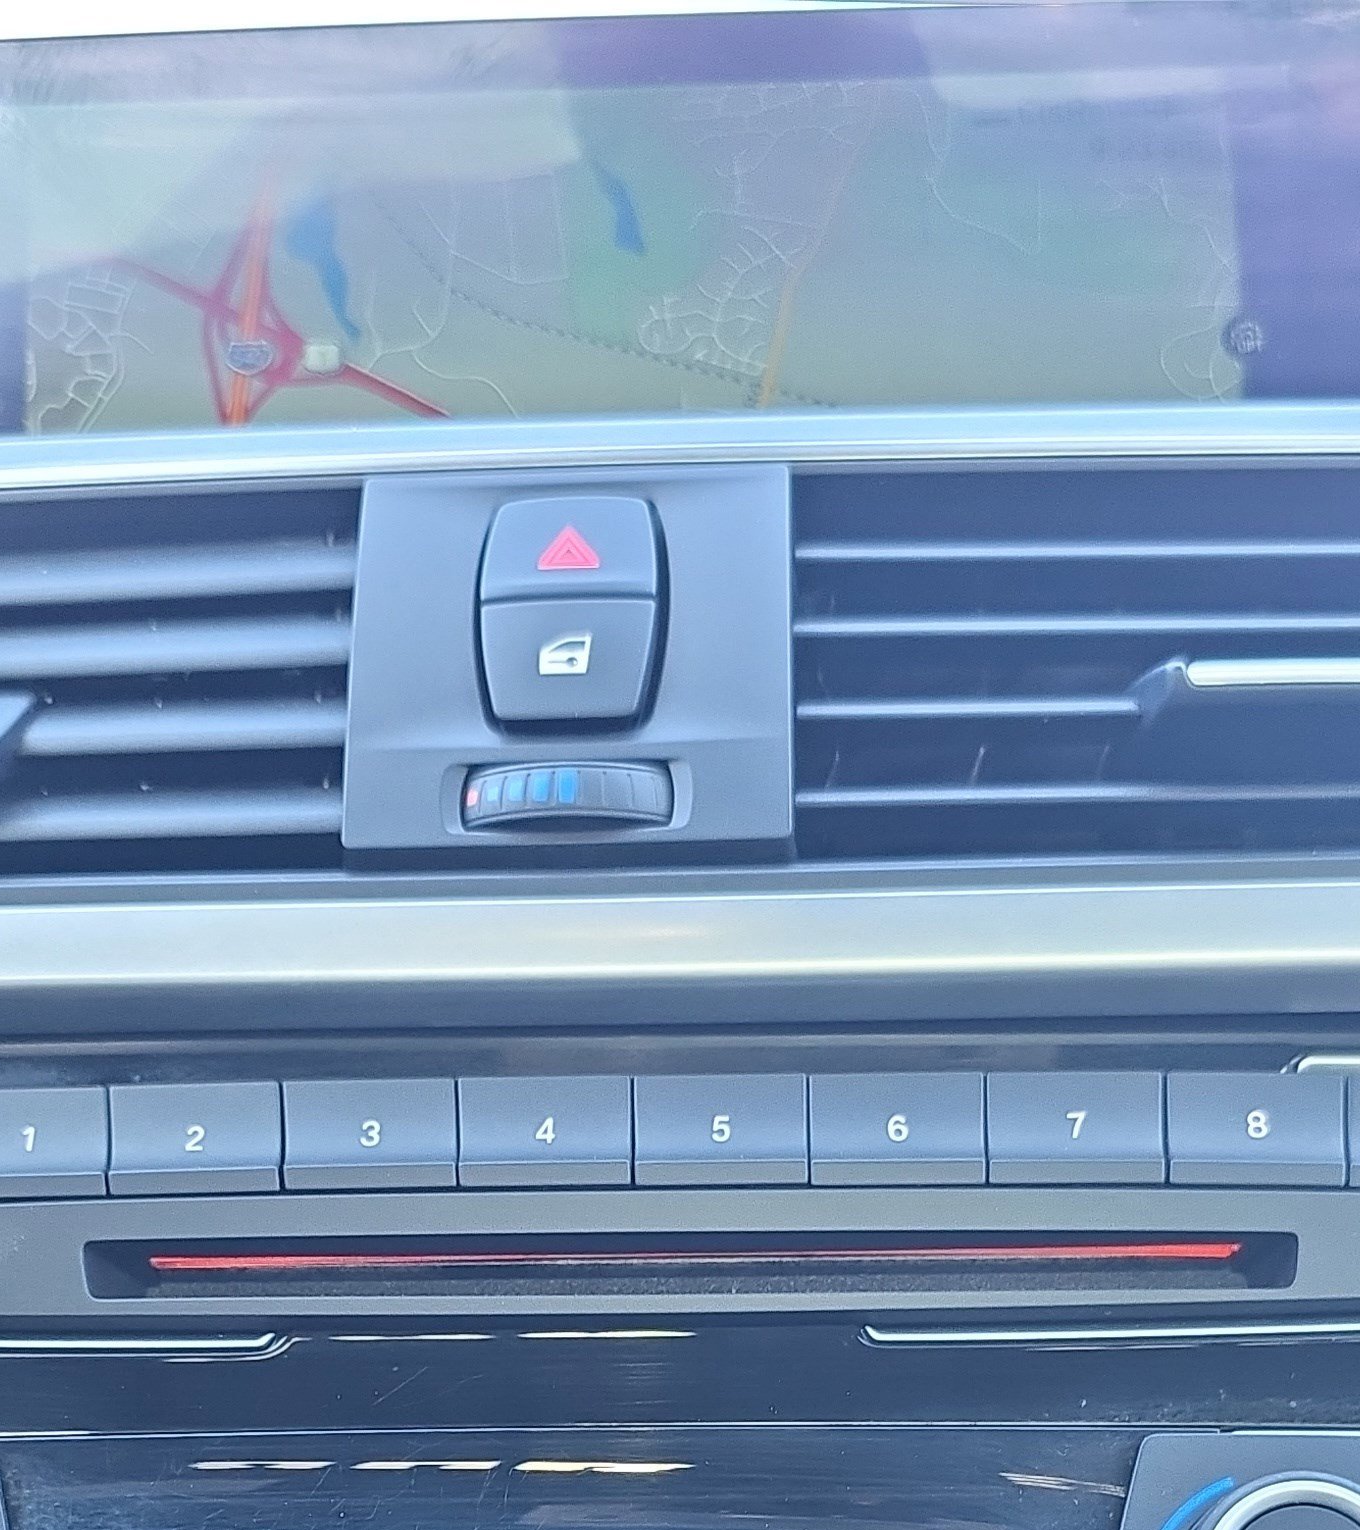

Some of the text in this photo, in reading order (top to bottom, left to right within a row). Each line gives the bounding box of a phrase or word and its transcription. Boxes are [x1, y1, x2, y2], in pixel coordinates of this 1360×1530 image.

[184, 1124, 207, 1152] 2
[359, 1119, 382, 1148] 3
[534, 1116, 557, 1145] 4
[710, 1114, 733, 1143] 5
[887, 1113, 910, 1143] 6
[1067, 1110, 1088, 1140] 7
[1246, 1109, 1270, 1139] 8
[21, 1125, 36, 1153] 1
